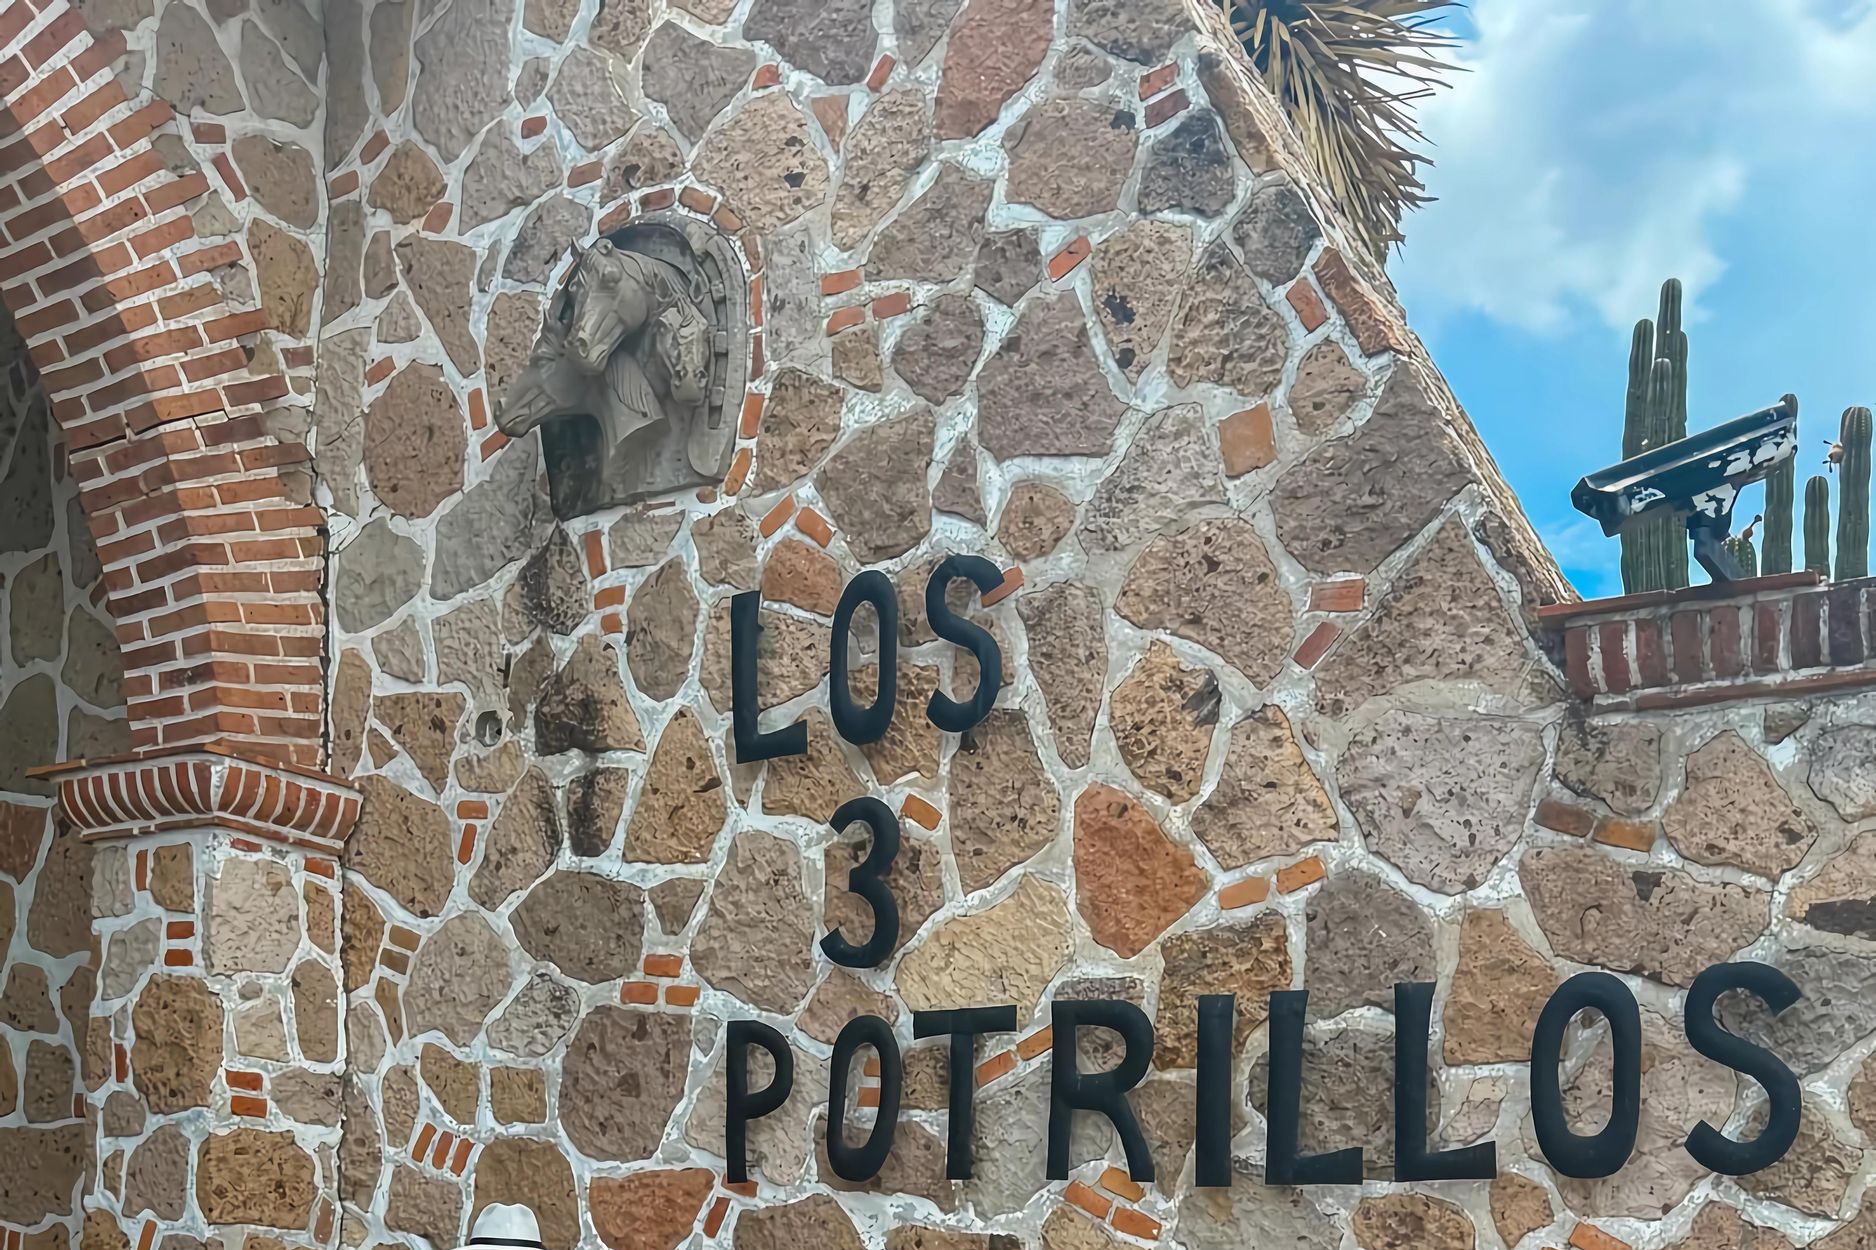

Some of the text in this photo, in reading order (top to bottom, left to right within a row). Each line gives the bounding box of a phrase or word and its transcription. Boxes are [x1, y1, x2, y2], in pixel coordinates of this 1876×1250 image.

[731, 554, 1005, 764] LOS
[819, 797, 900, 968] 3
[725, 961, 1802, 1188] POTRILLOS
